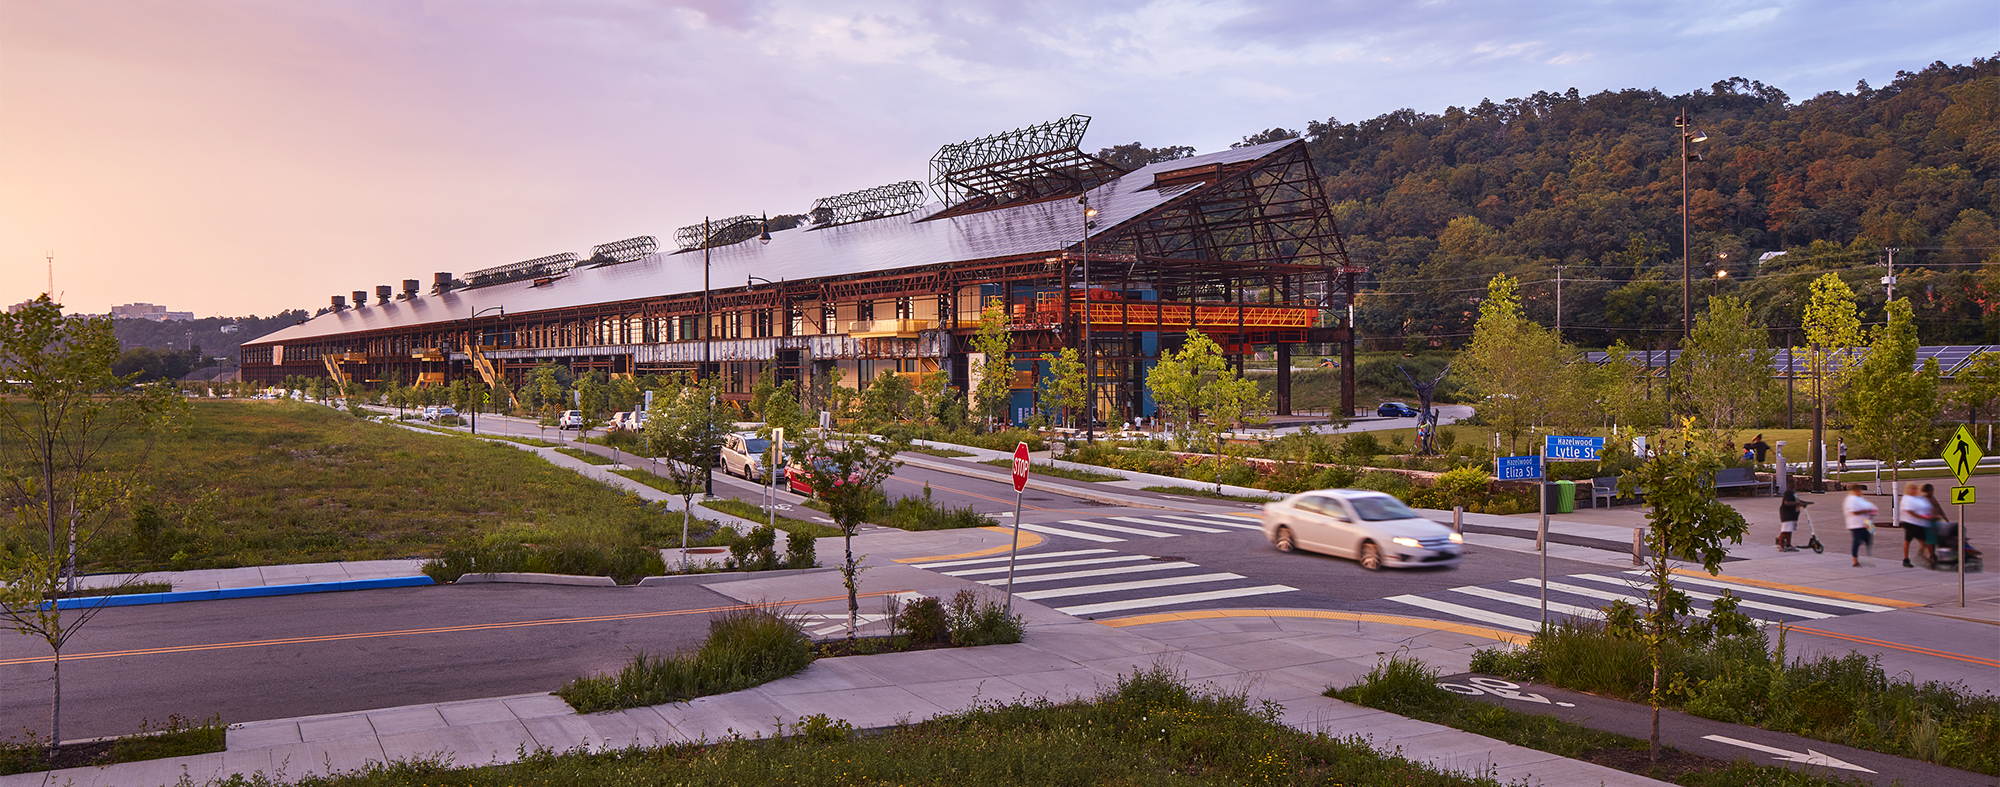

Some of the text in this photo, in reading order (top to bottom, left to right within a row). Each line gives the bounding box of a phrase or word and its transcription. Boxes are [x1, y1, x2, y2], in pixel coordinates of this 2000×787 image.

[1556, 446, 1594, 458] Lytle St
[1014, 457, 1028, 478] STOP
[1506, 466, 1533, 478] Eliza St
